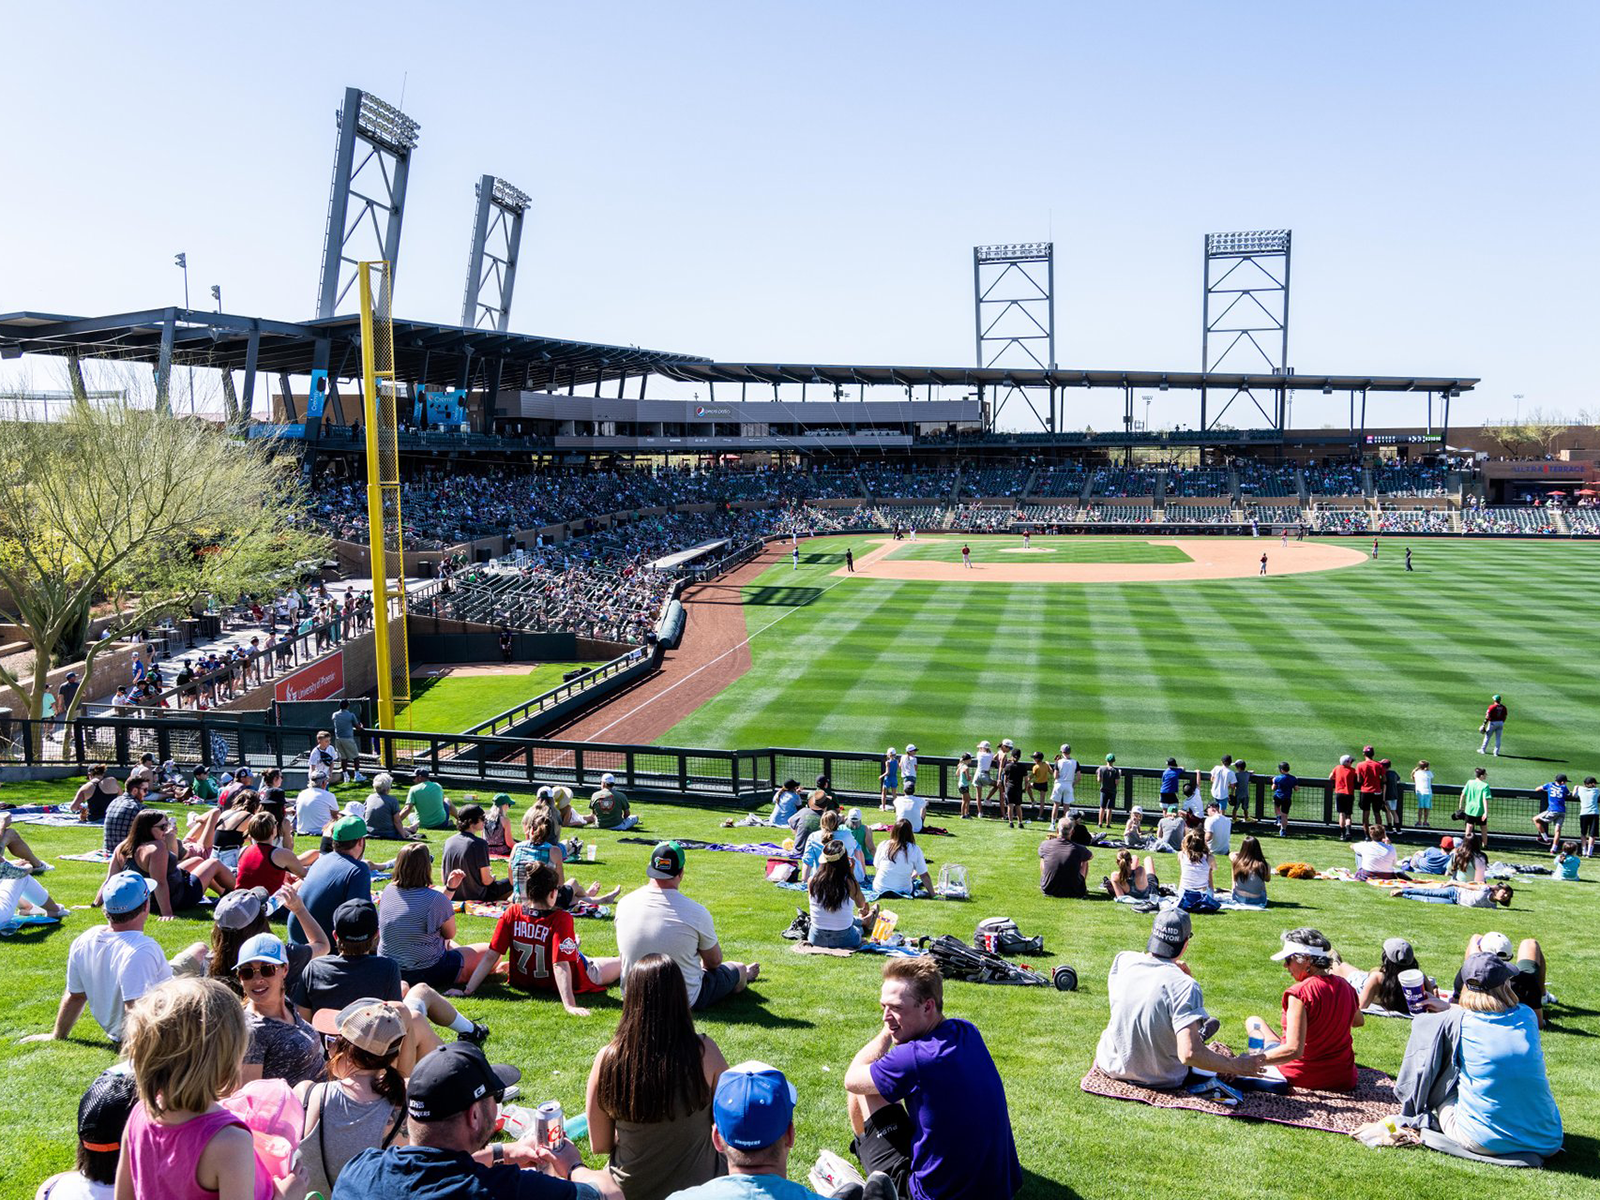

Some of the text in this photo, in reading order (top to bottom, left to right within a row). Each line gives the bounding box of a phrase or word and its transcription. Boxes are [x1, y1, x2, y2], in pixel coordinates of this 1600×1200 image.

[1549, 465, 1585, 473] TERRACE
[298, 682, 317, 700] University
[1550, 790, 1563, 798] 35
[514, 920, 550, 943] HADER
[513, 940, 549, 978] 71
